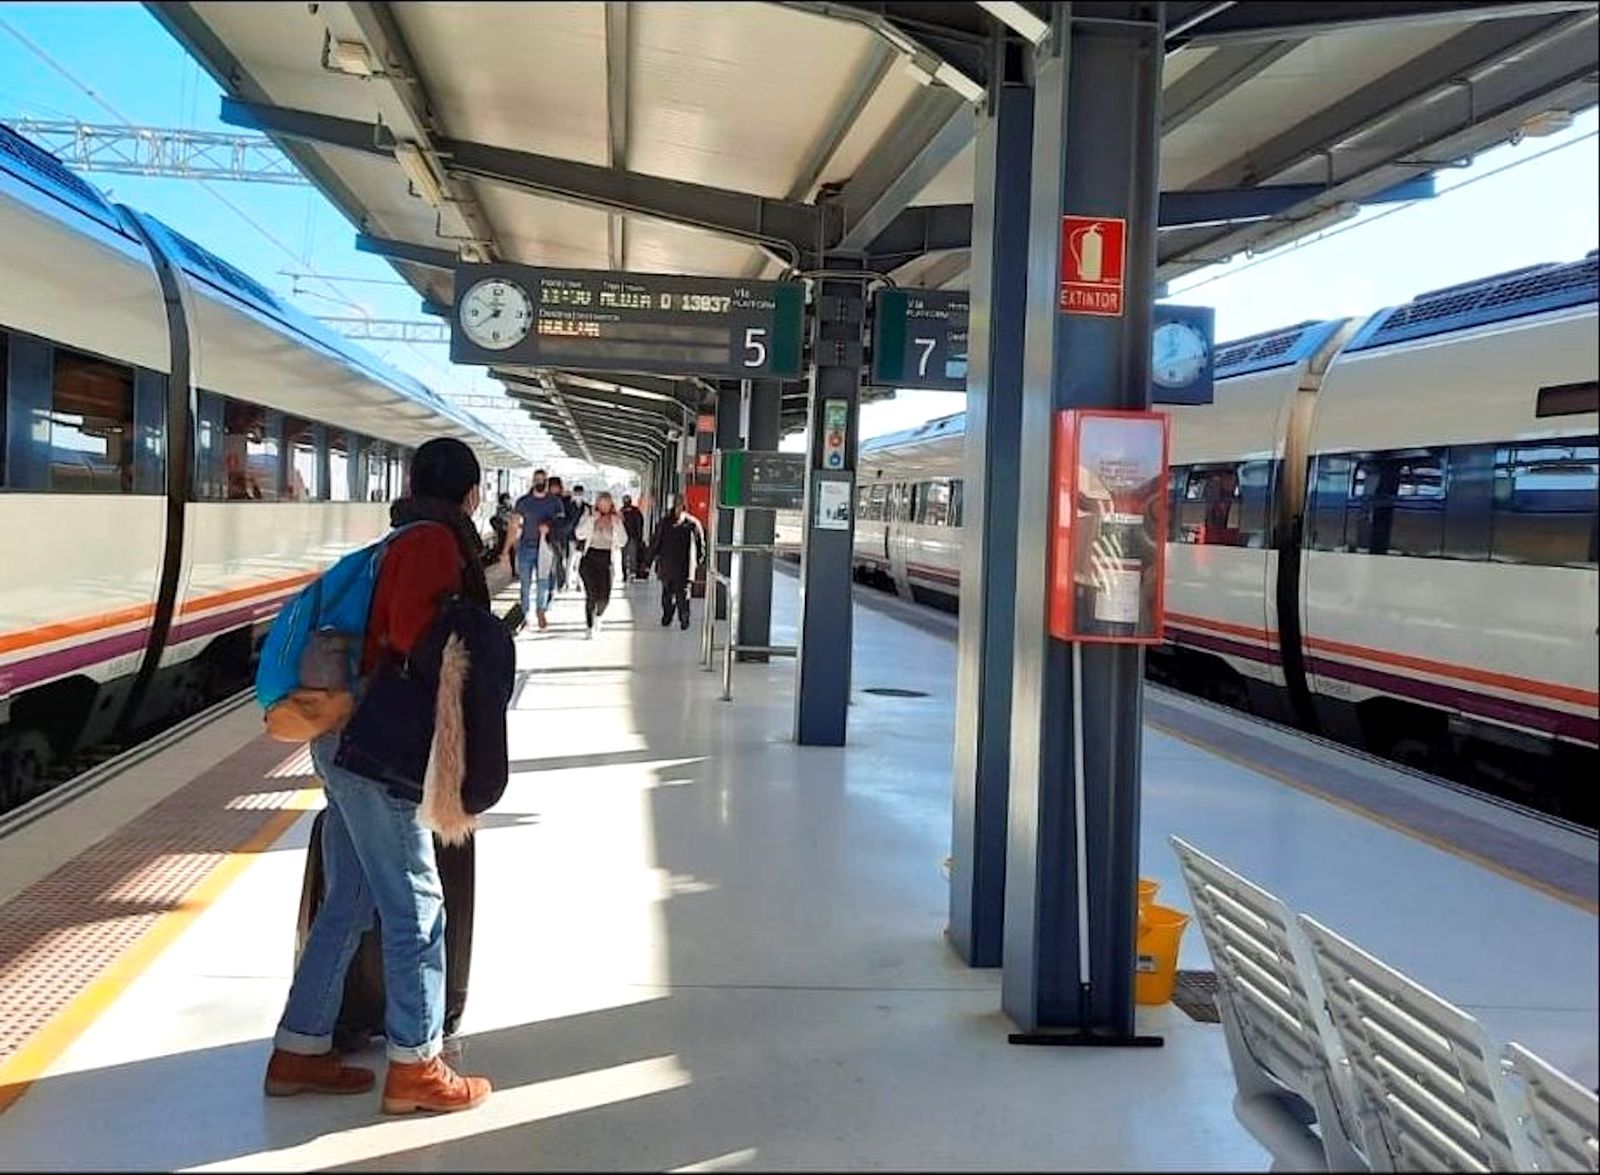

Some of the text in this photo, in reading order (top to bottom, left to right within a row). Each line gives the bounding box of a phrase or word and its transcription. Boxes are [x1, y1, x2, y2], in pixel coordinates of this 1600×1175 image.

[1061, 289, 1118, 310] EXTINTOR
[743, 327, 766, 367] 5
[915, 338, 936, 376] 7
